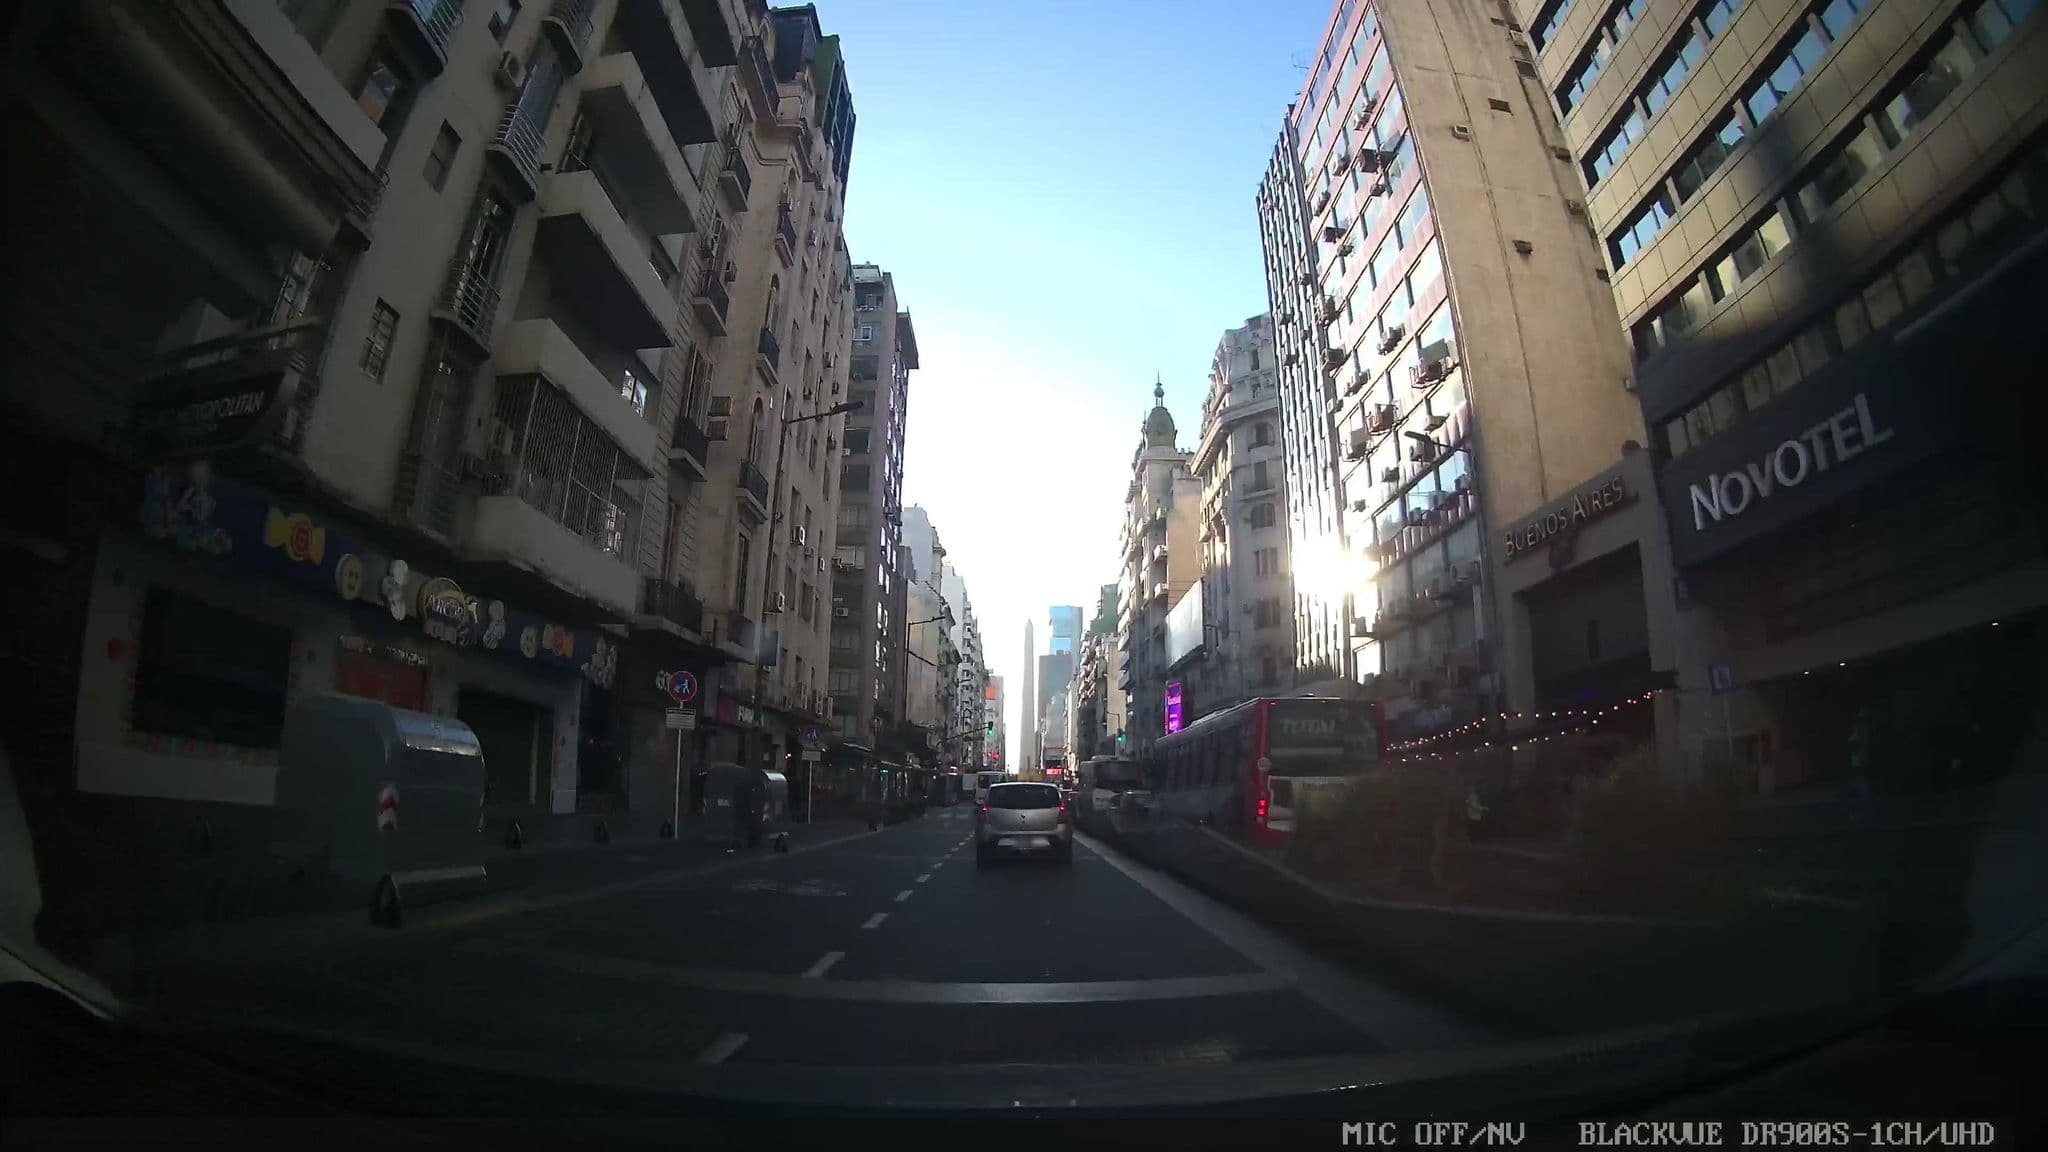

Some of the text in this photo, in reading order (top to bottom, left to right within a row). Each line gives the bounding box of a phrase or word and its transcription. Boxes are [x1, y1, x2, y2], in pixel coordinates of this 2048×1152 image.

[1504, 475, 1623, 557] BUENOS AIRES
[1690, 393, 1895, 531] NOVOTEL
